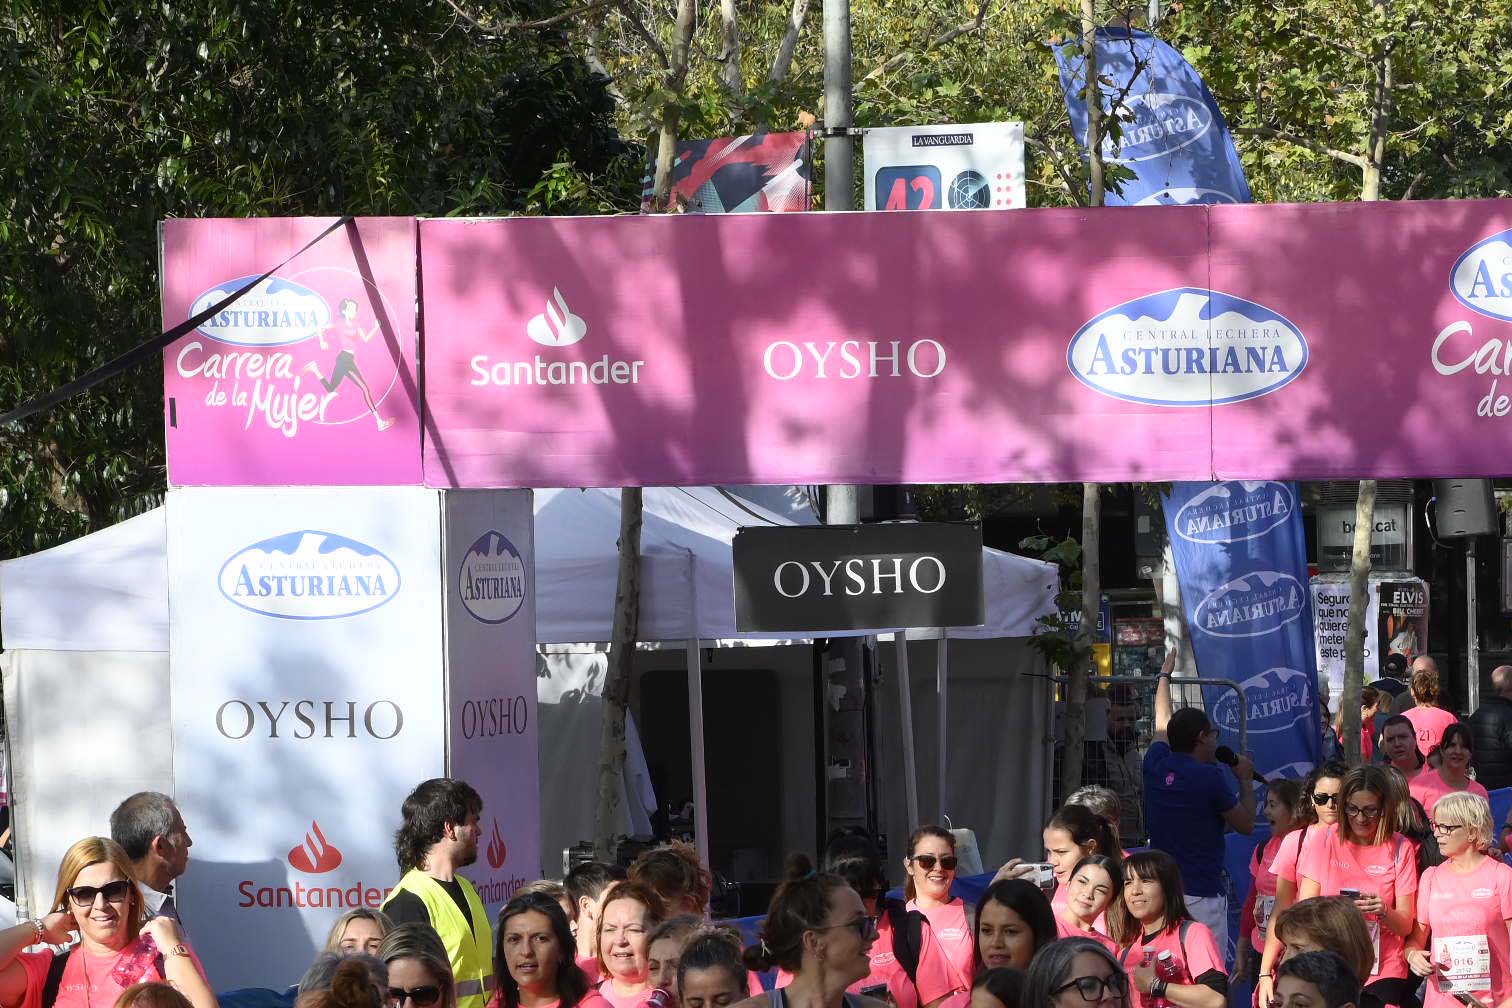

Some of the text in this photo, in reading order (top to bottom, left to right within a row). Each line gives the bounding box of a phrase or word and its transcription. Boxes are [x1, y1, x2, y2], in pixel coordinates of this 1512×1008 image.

[925, 134, 974, 146] VANGUARDIA
[1123, 327, 1282, 341] CENTRAL LECHERA
[177, 342, 294, 380] Carrera
[470, 354, 646, 386] Santander
[763, 338, 947, 381] OYSHO
[1086, 333, 1291, 376] ASTURIANA
[205, 376, 339, 438] de la Mujer
[1476, 379, 1510, 417] de
[233, 563, 387, 598] ASTURIANA
[464, 564, 522, 601] ASTURIANA
[774, 556, 947, 598] OYSHO
[1318, 608, 1336, 622] que
[1393, 591, 1424, 604] ELVIS
[1320, 648, 1339, 658] este
[215, 699, 404, 741] OYSHO
[461, 695, 528, 741] OYSHO
